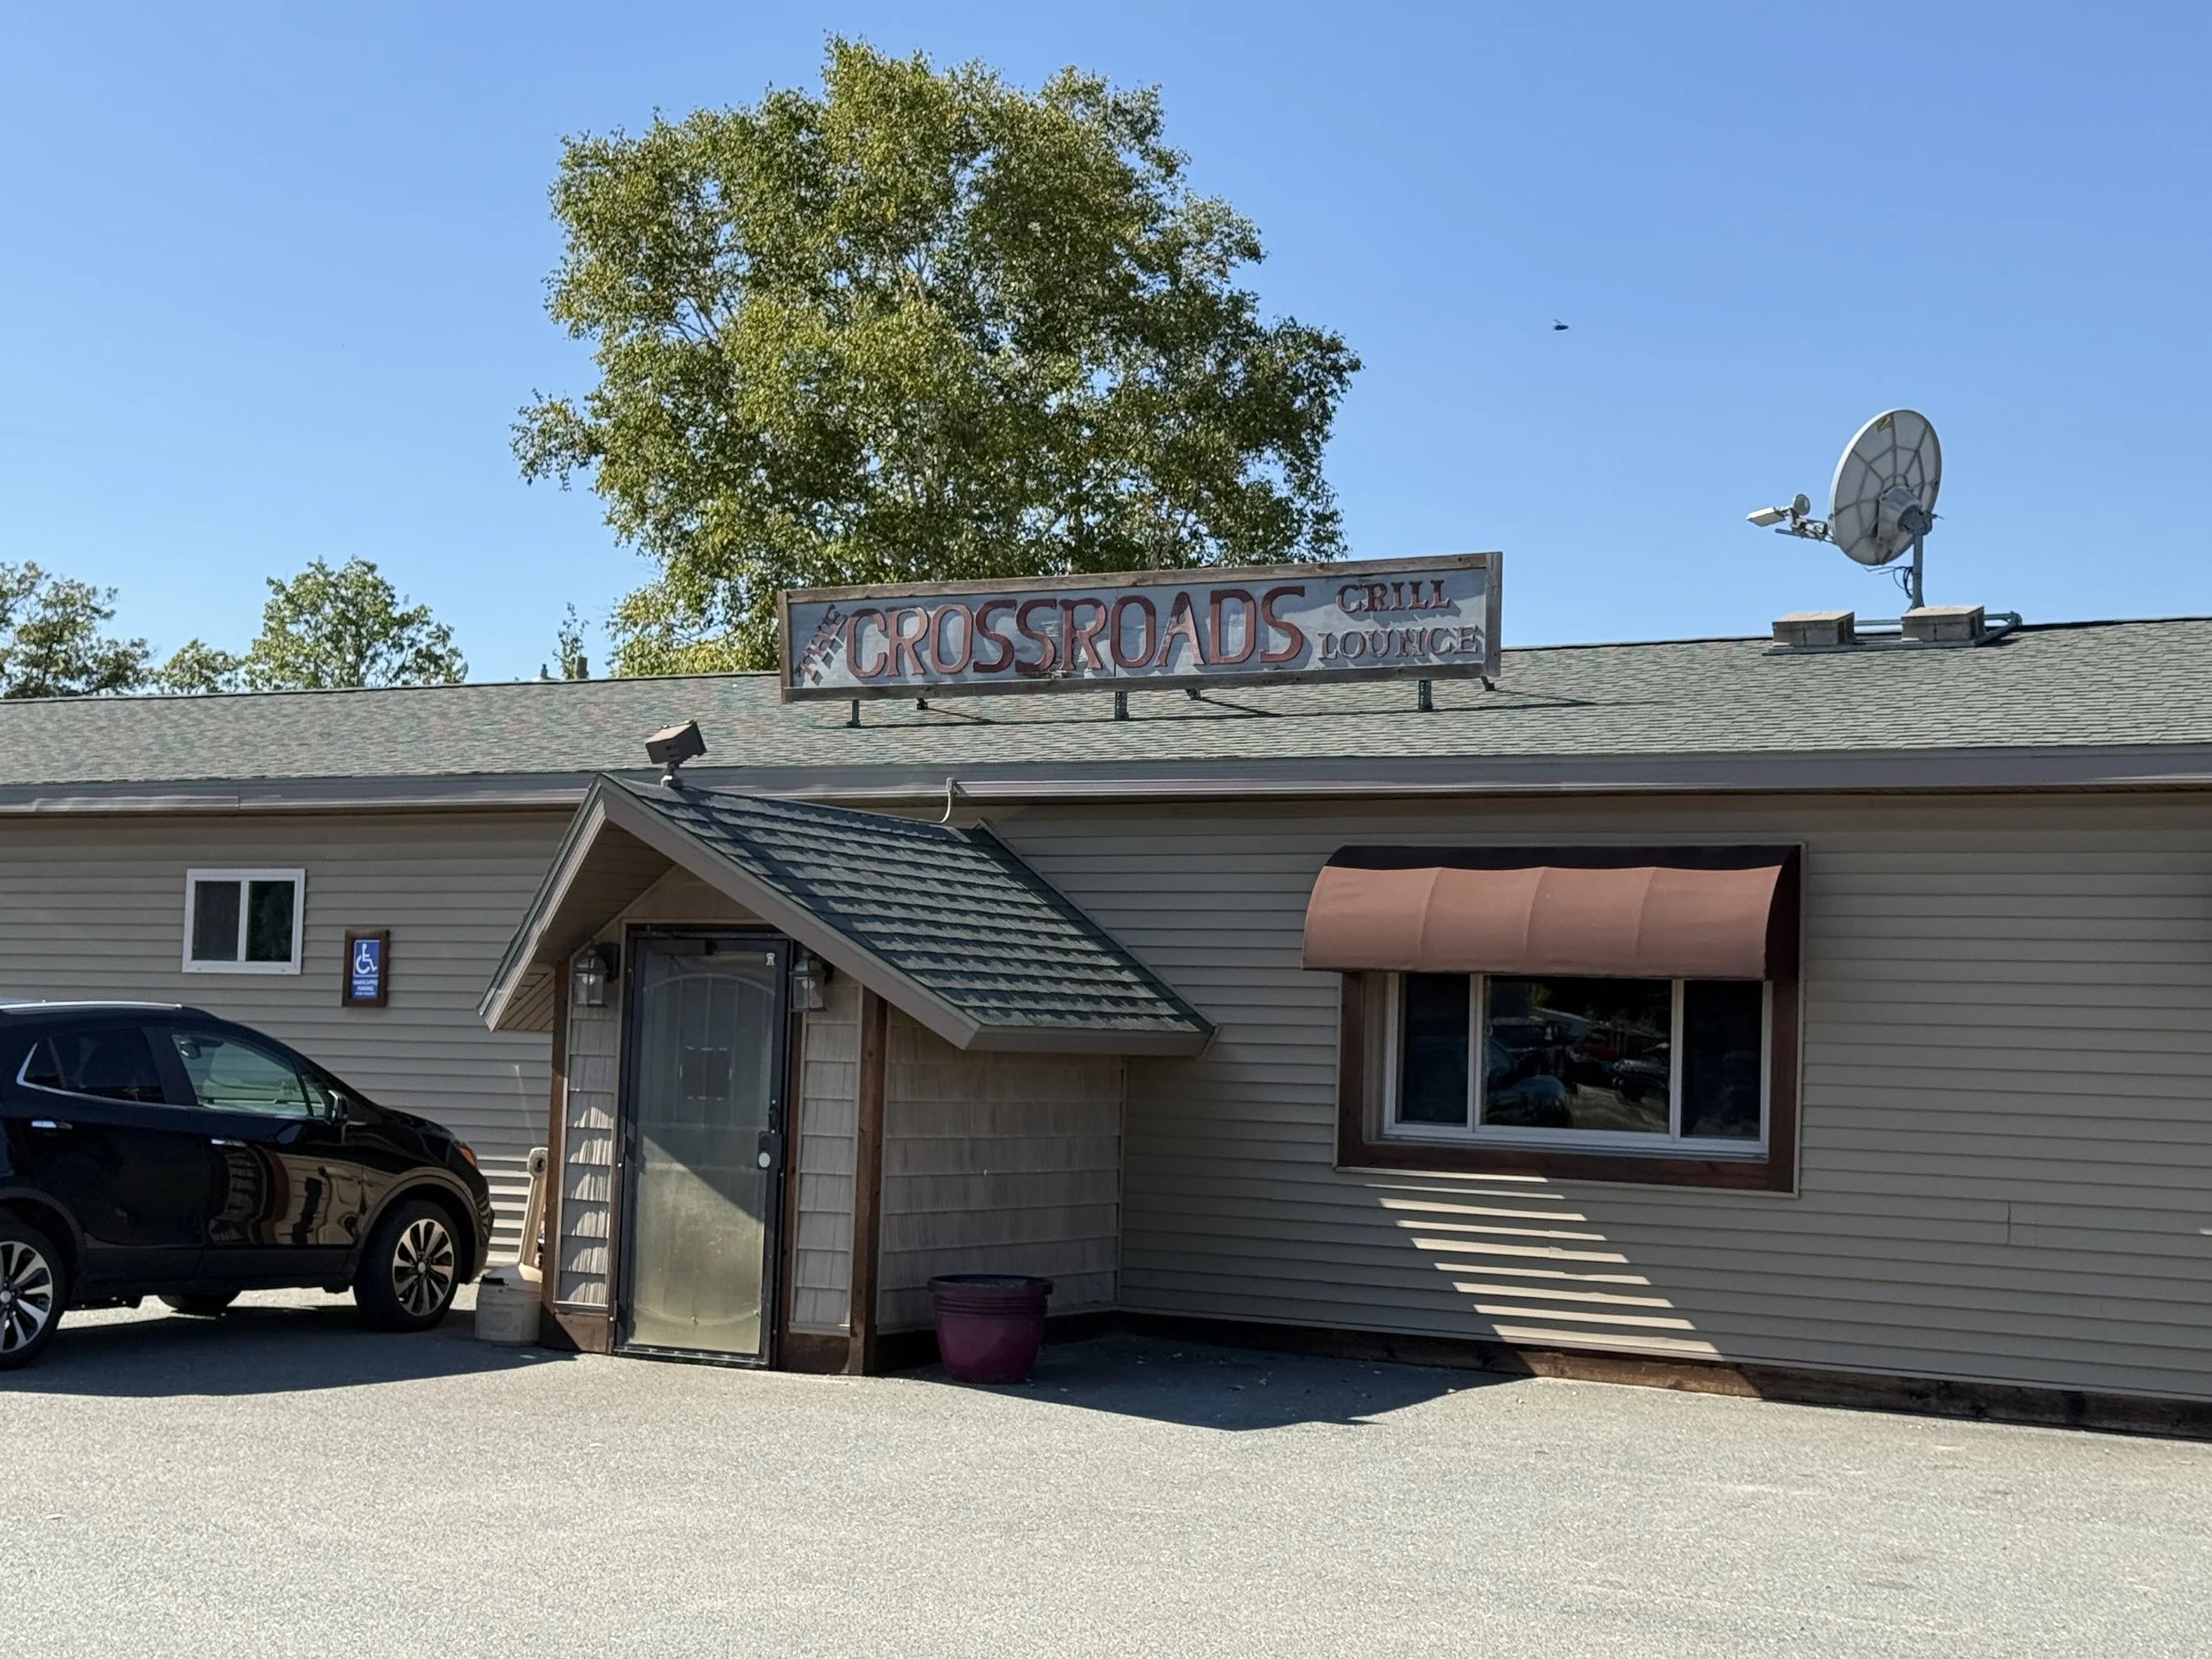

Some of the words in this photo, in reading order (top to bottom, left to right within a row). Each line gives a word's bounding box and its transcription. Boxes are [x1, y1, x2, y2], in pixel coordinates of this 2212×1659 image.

[1335, 580, 1450, 613] GRILL
[795, 604, 849, 681] THE
[845, 586, 1306, 679] CROSSROADS
[1317, 623, 1479, 660] LOUNGE
